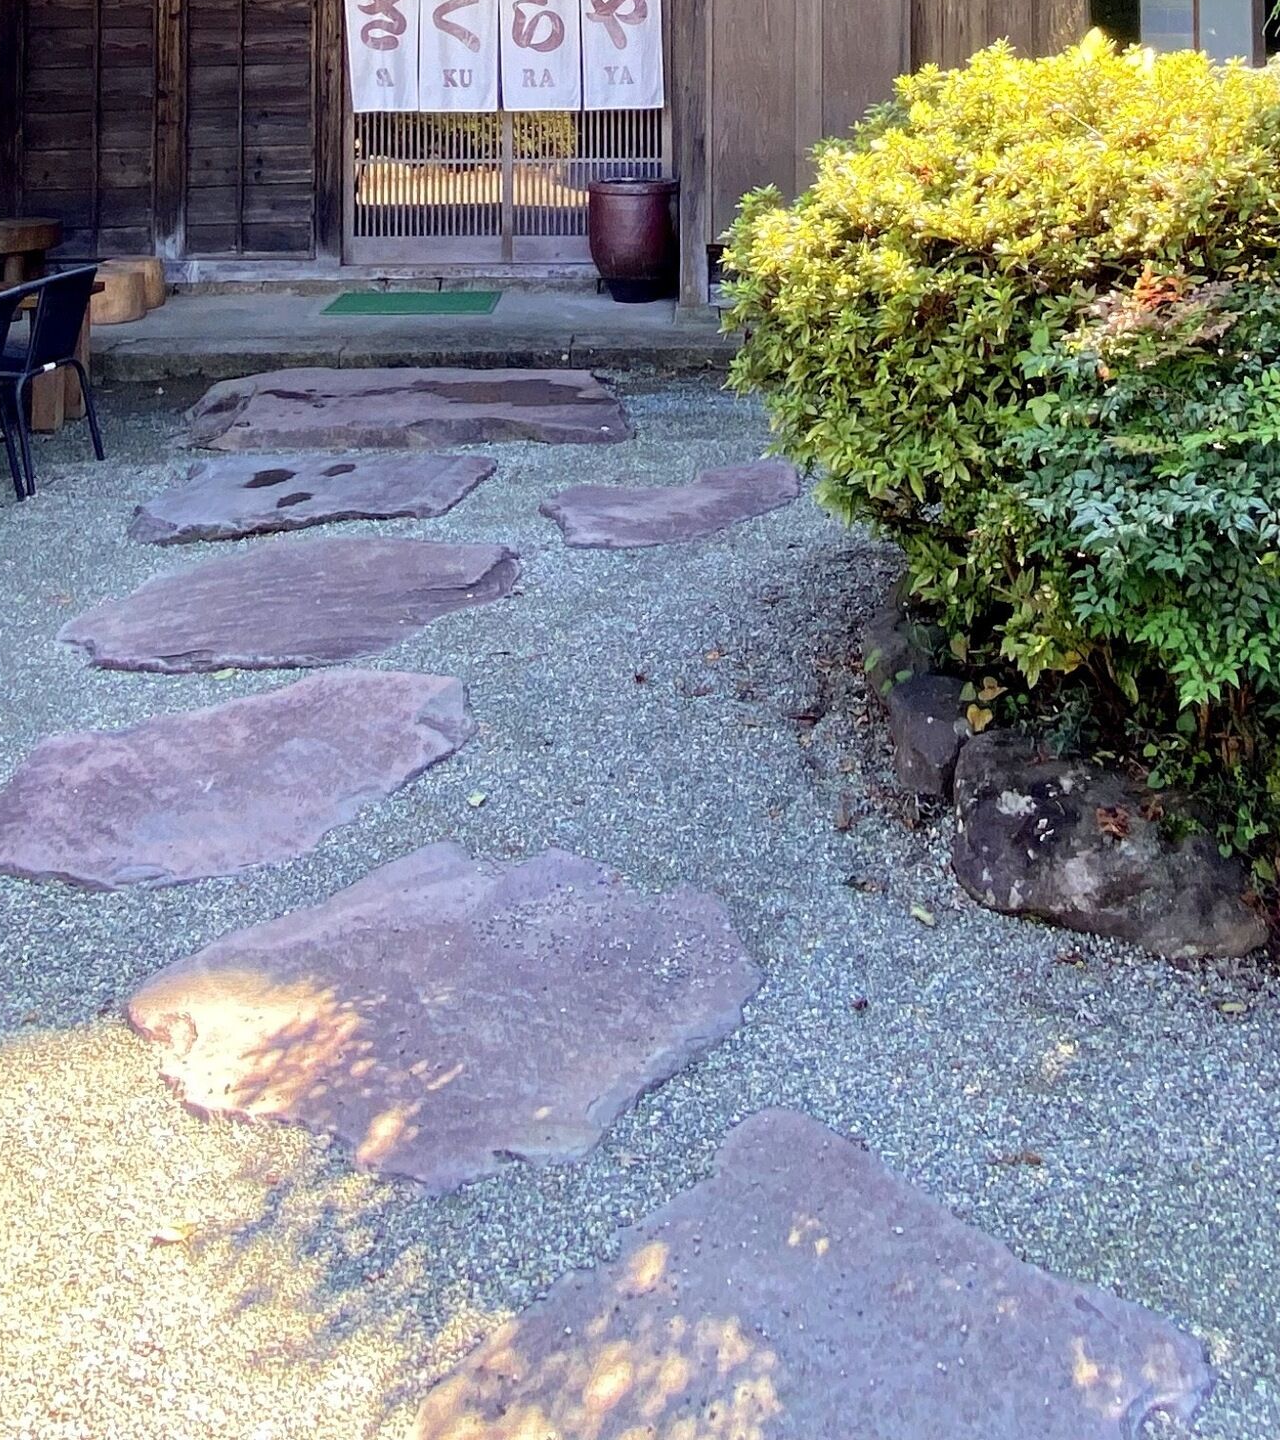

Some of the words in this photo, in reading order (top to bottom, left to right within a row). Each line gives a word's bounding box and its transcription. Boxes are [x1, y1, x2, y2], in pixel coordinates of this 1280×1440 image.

[442, 68, 473, 88] KU
[521, 68, 556, 88] RA
[603, 65, 635, 85] YA
